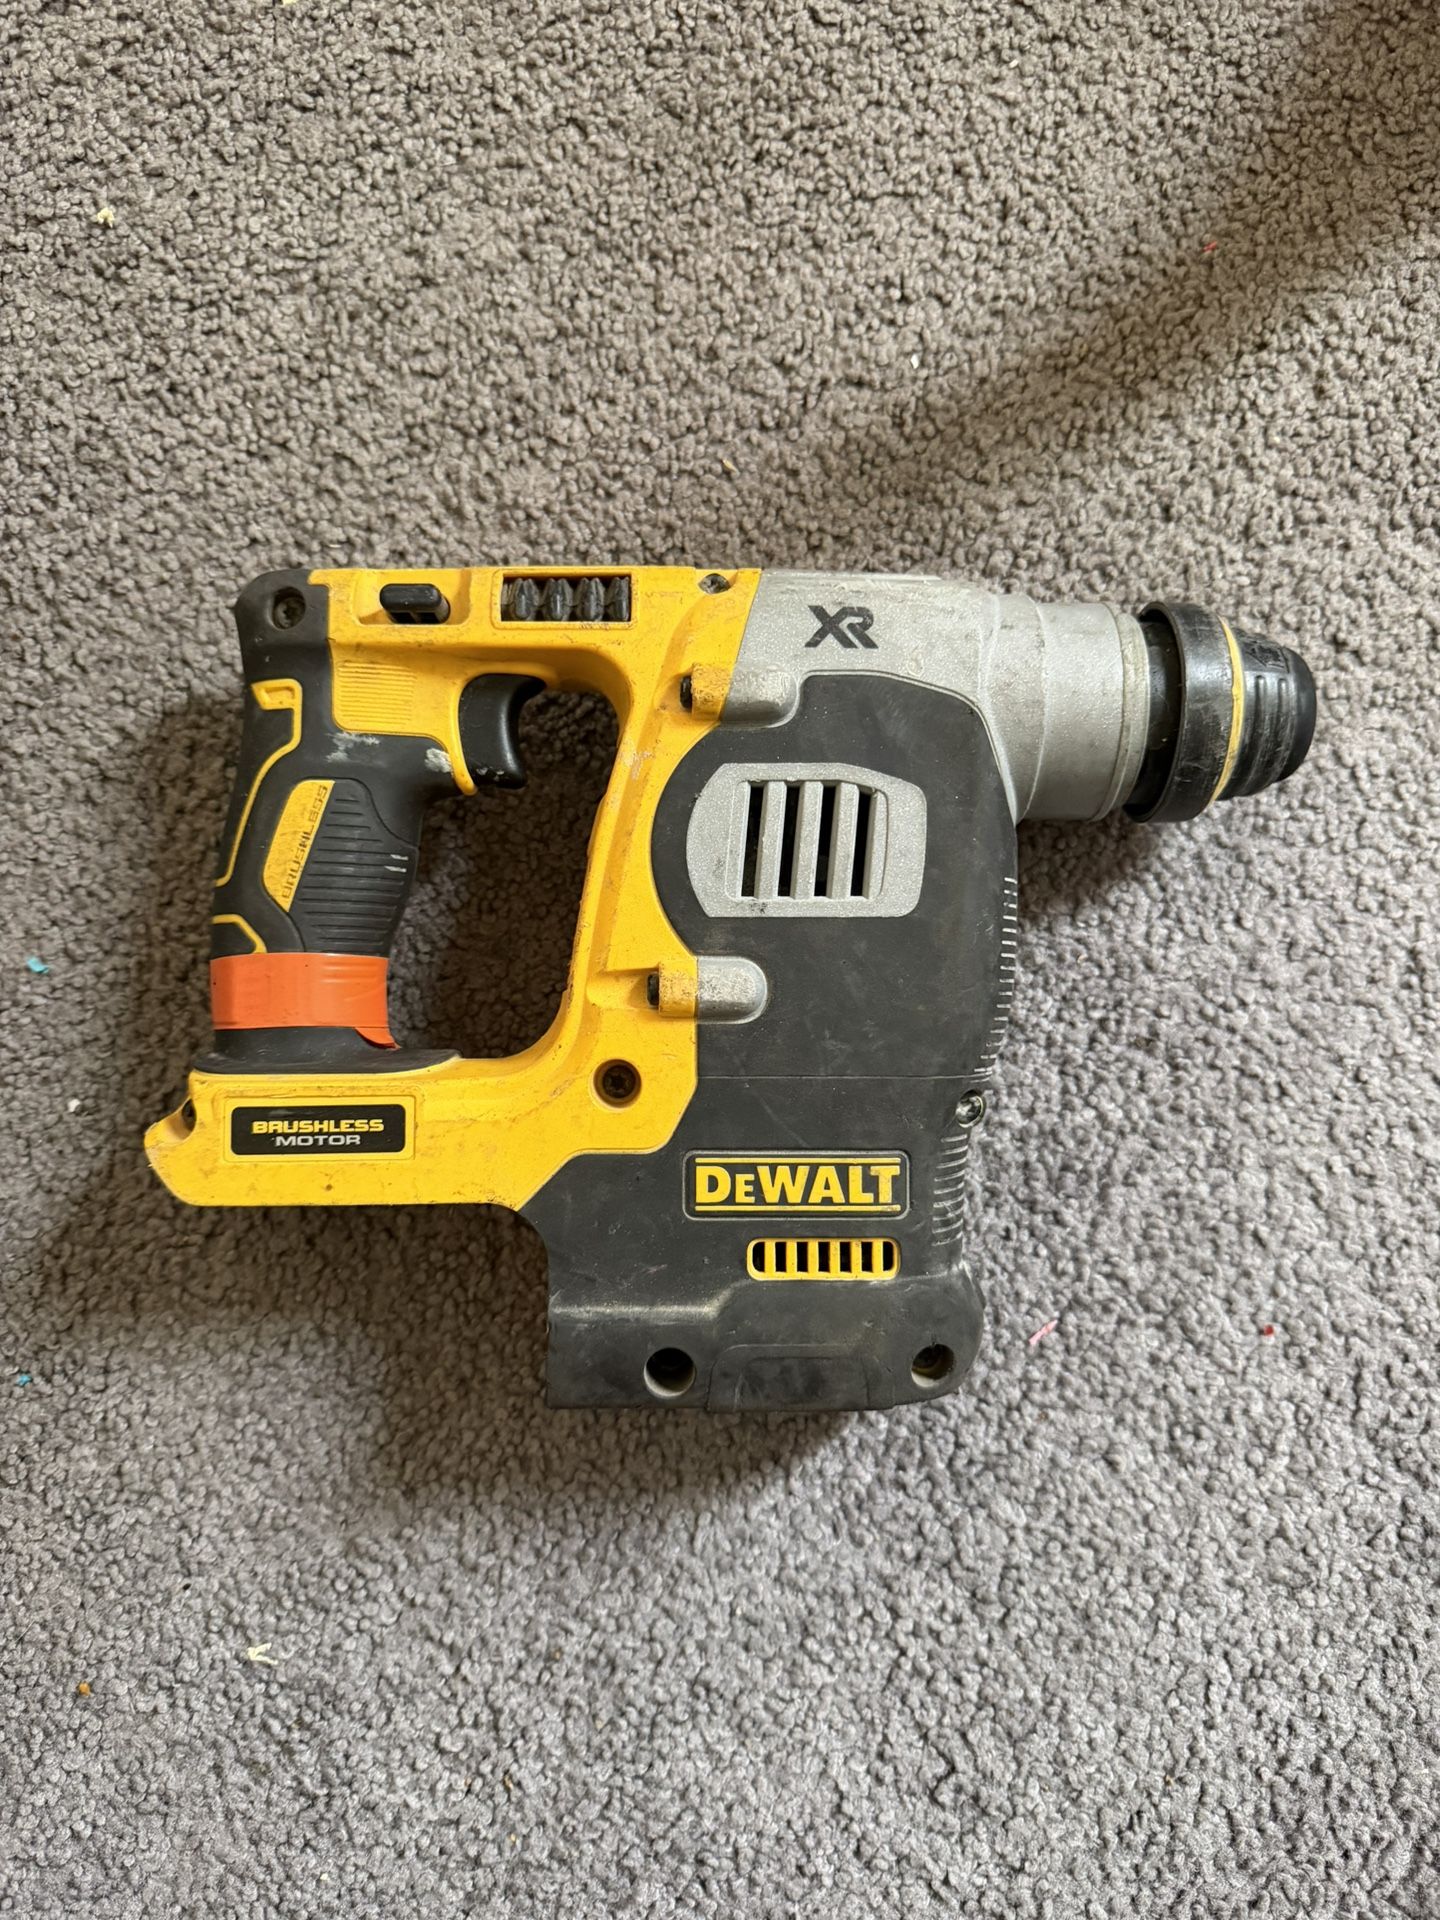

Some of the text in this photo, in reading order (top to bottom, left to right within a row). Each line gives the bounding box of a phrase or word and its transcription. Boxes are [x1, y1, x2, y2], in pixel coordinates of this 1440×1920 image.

[804, 605, 879, 649] XR
[281, 784, 328, 900] BRUSHLESS
[252, 1119, 385, 1134] BRUSHLESS
[275, 1134, 361, 1147] MOTOR
